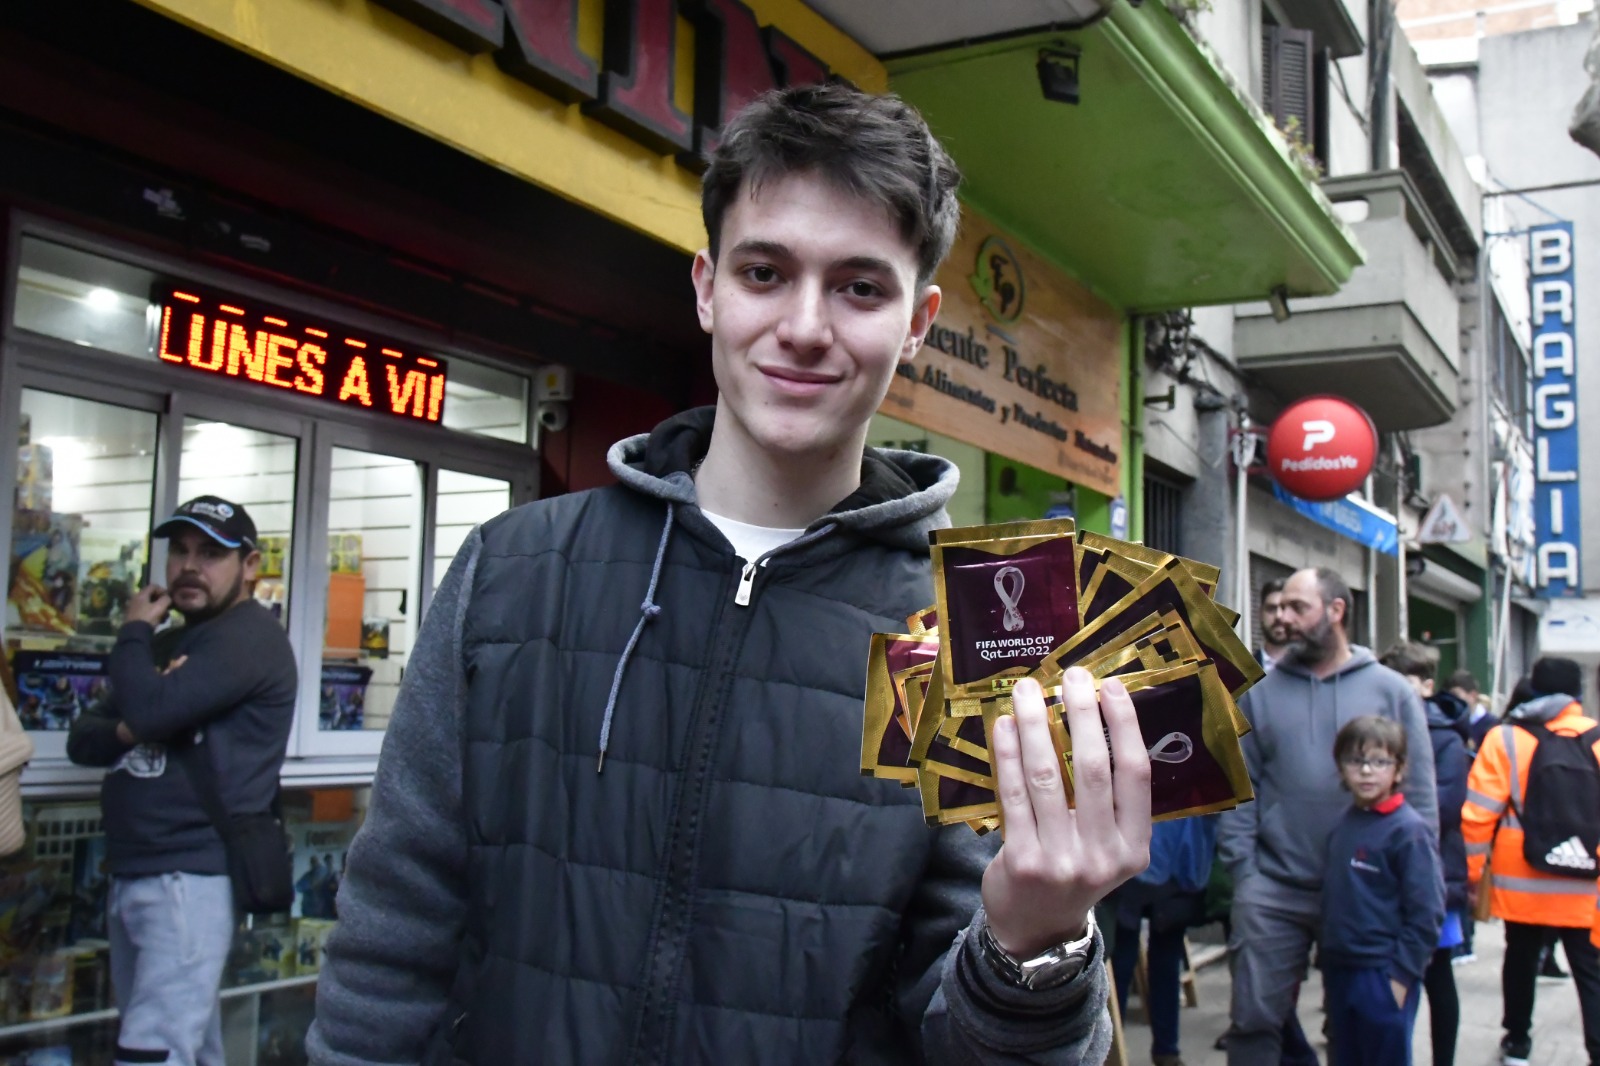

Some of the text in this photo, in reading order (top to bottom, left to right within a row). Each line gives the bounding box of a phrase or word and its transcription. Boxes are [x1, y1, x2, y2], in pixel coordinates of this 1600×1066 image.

[159, 306, 328, 395] LUNES
[339, 355, 373, 406] A
[1000, 405, 1012, 424] y
[1531, 229, 1579, 588] BRAGLIA
[1281, 455, 1359, 472] PedidosYa
[975, 636, 1055, 650] FIFA WORLD CUP
